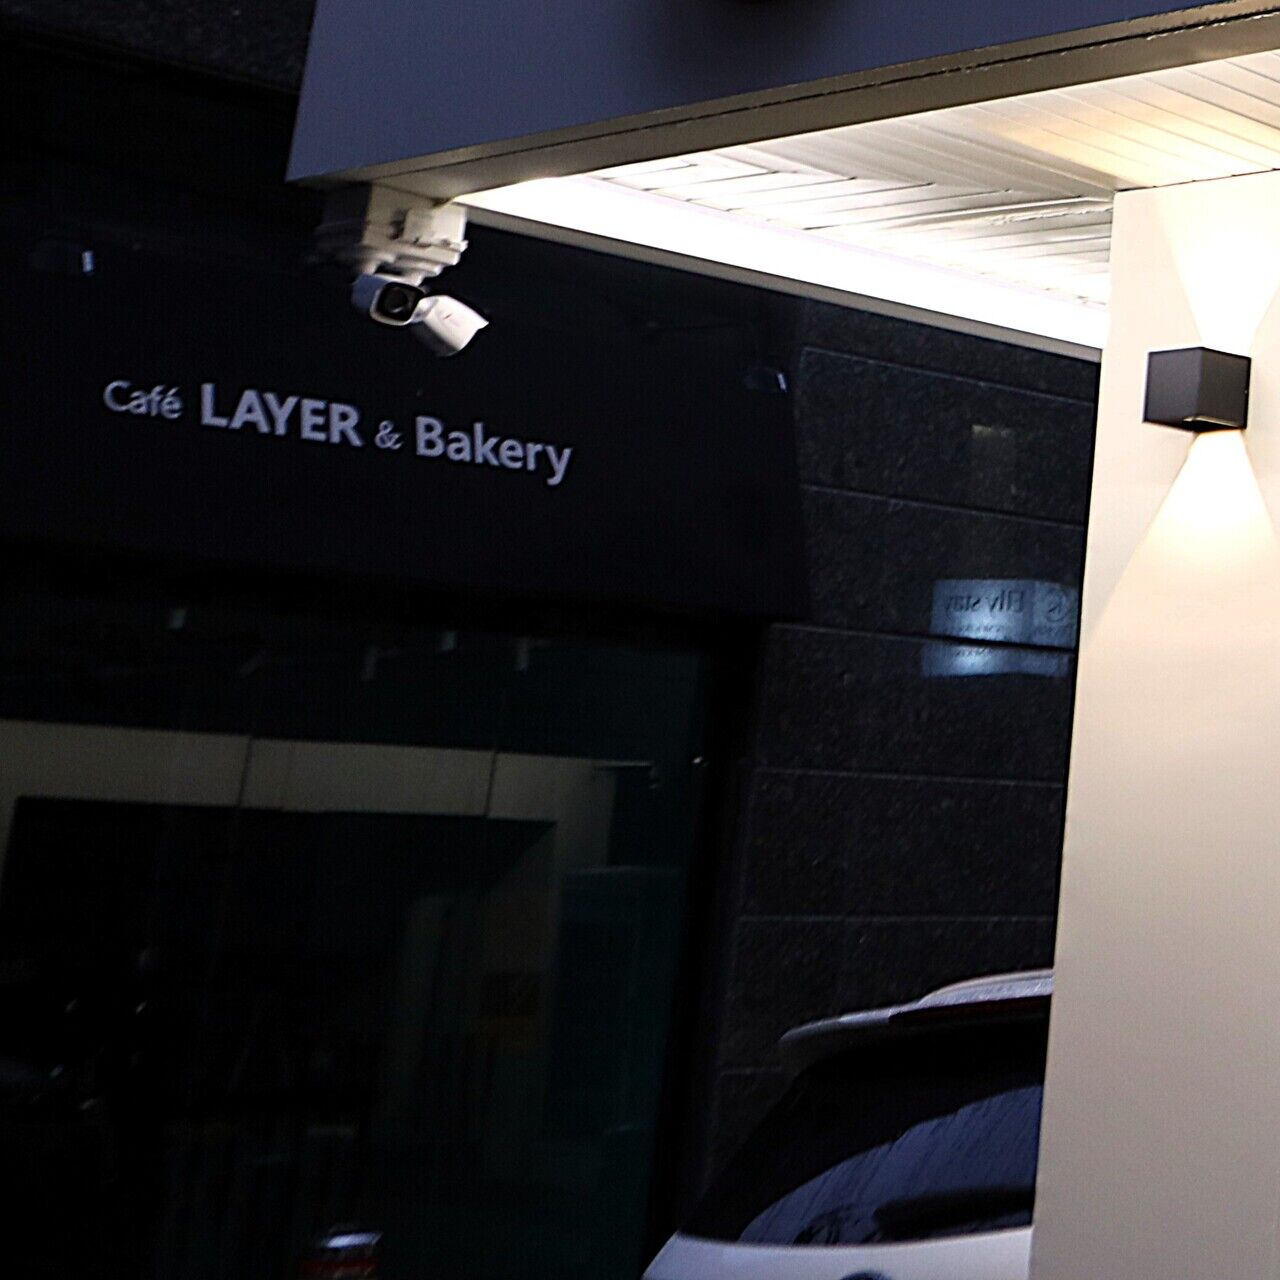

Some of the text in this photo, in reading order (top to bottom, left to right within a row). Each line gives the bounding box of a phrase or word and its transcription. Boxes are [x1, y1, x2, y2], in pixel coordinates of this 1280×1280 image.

[102, 379, 573, 487] Café LAYER & Bakery
